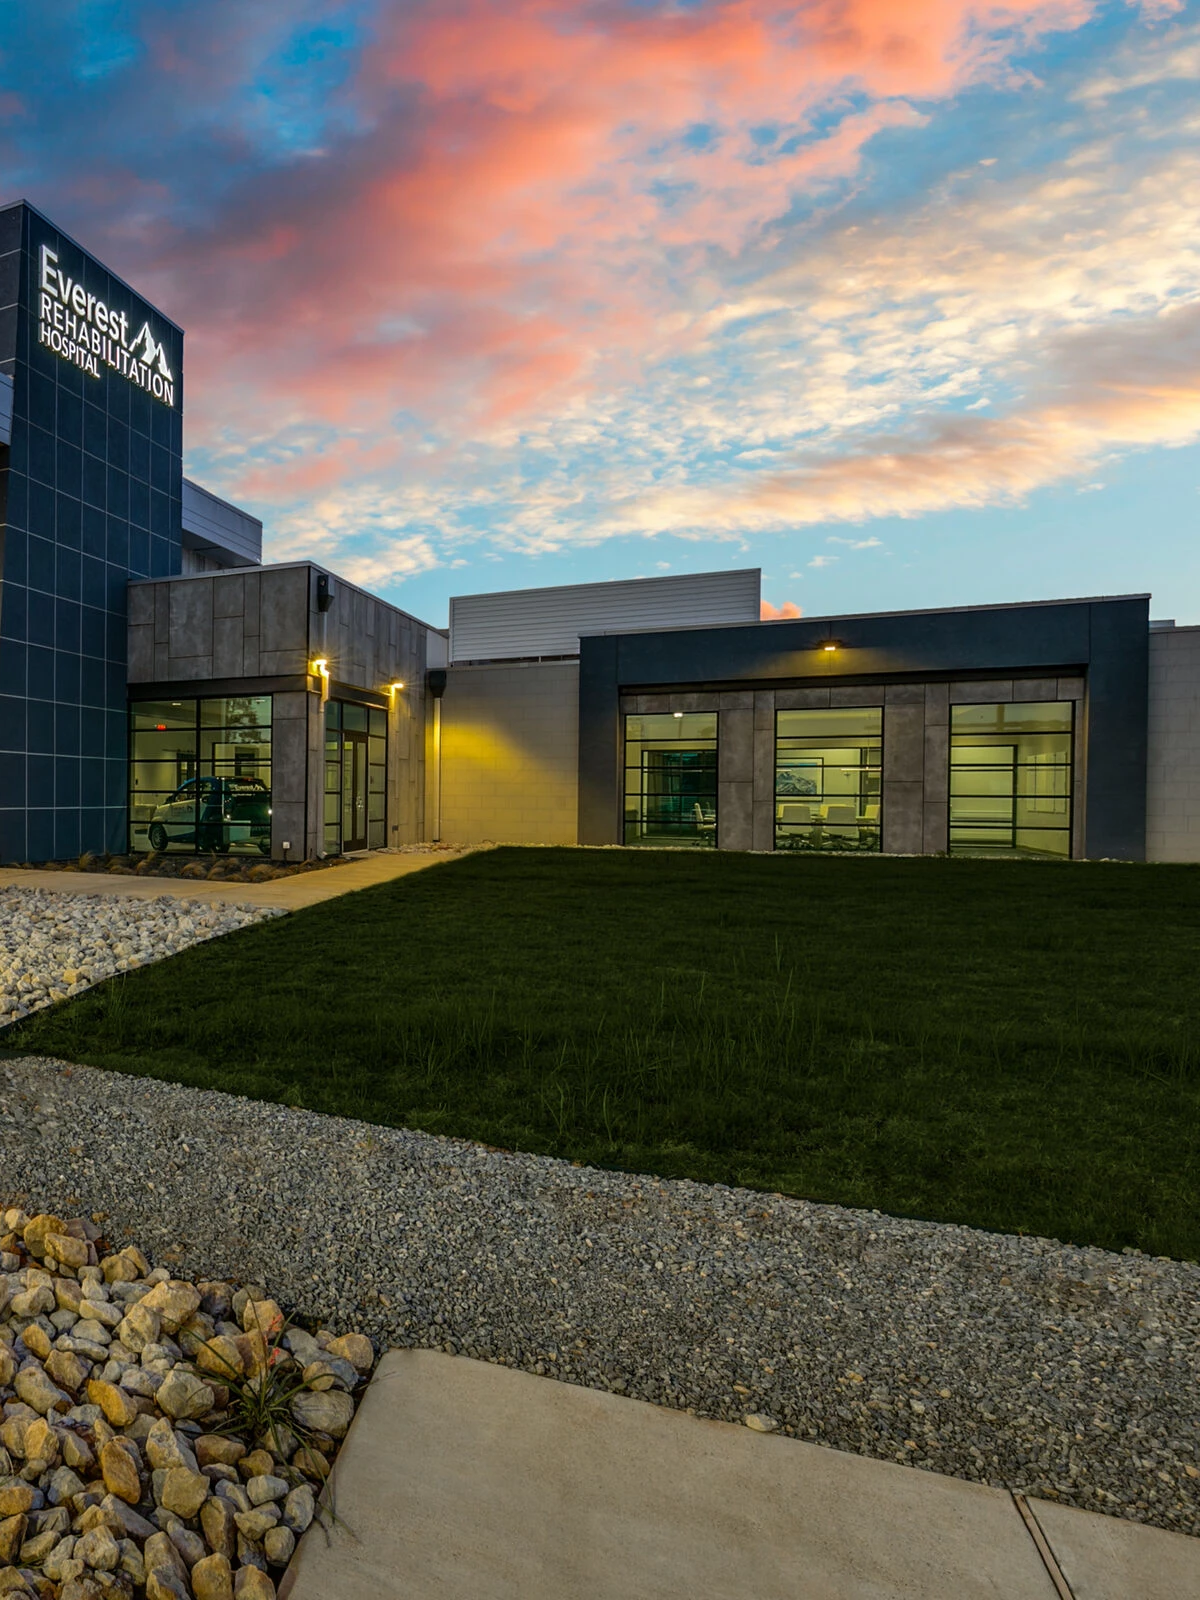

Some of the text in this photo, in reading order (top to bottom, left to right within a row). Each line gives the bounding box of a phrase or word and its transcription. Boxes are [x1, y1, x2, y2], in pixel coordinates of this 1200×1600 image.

[40, 245, 129, 348] Everest
[40, 292, 174, 406] REHABILITATION
[40, 321, 100, 378] HOSPITAL
